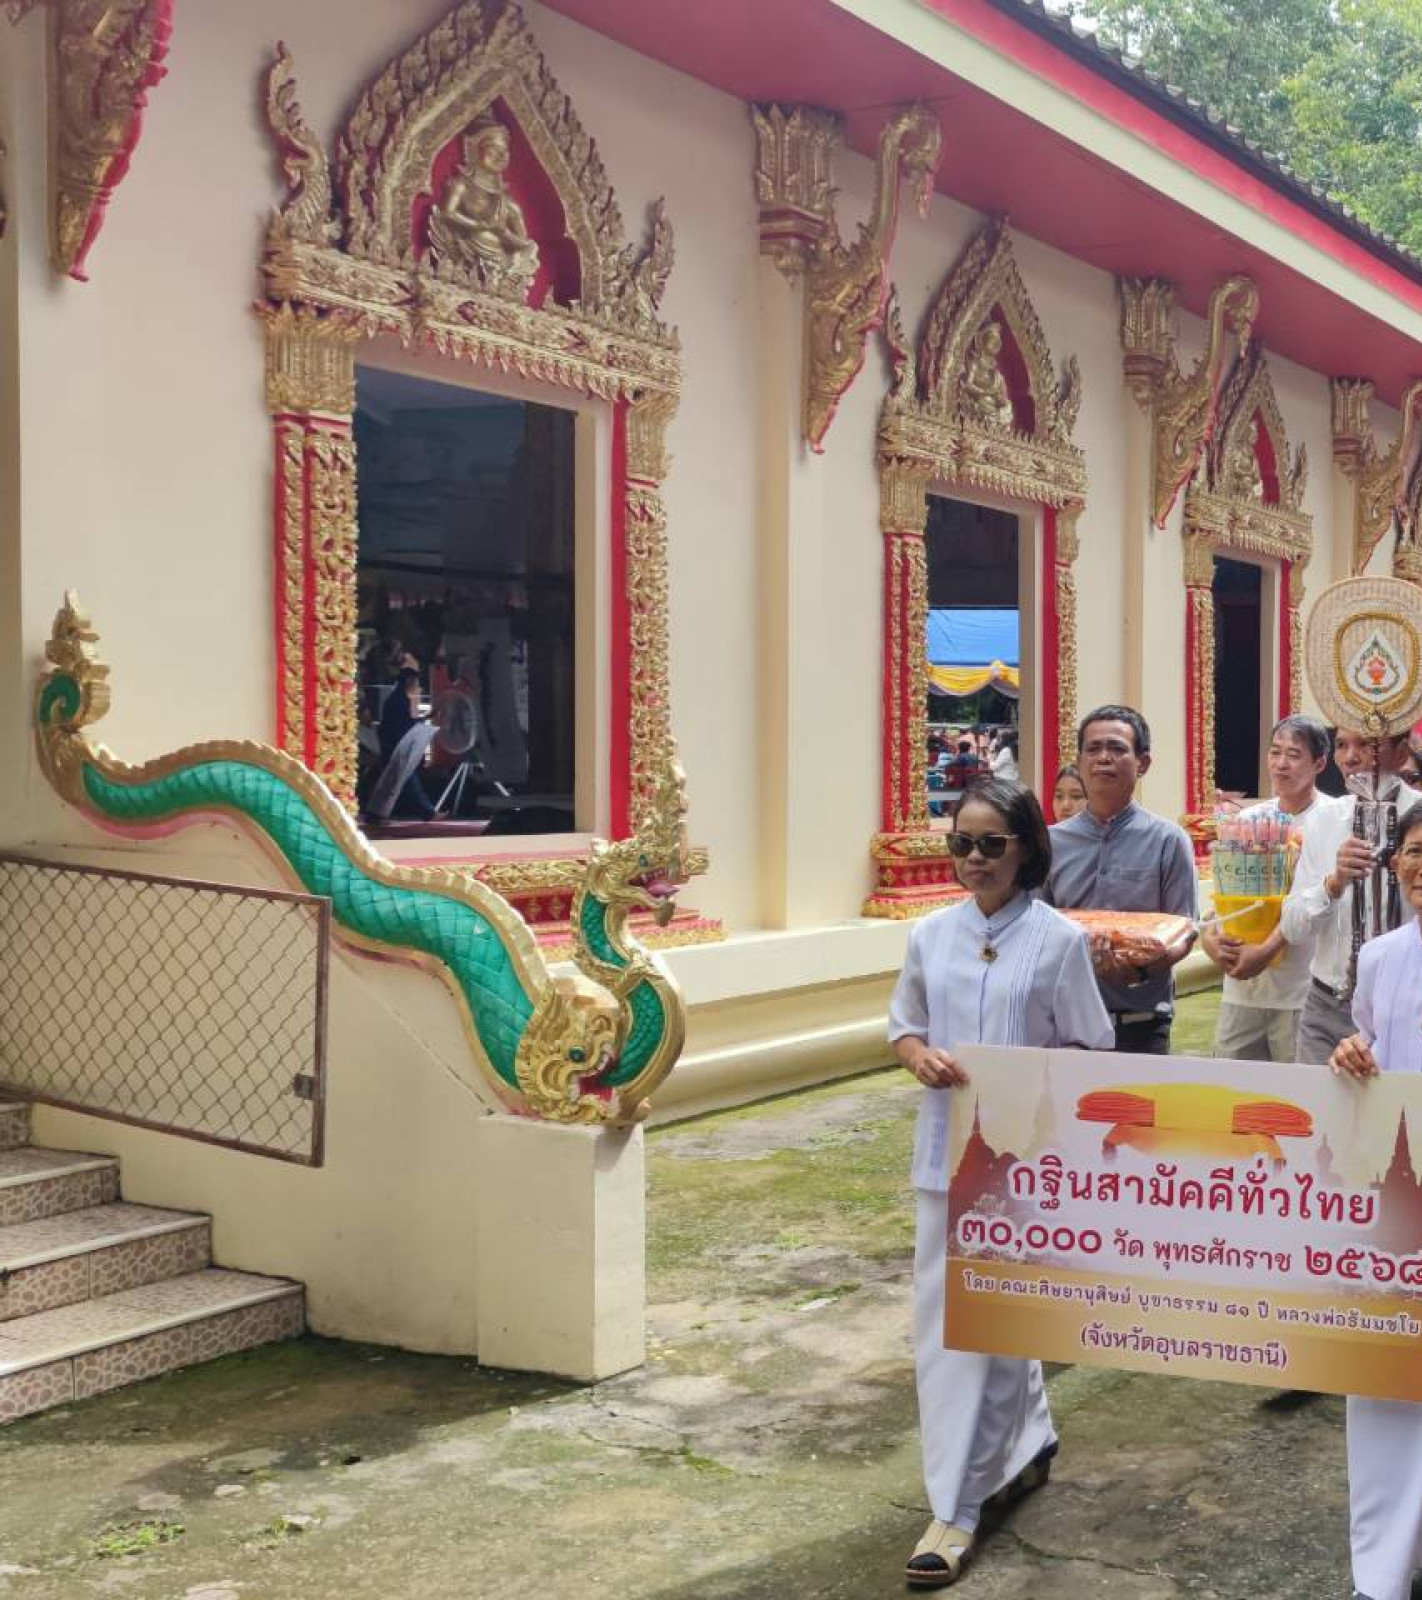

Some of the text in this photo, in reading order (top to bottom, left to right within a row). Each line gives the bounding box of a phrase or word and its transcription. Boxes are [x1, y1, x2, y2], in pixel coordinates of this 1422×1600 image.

[1012, 1155, 1374, 1225] กฐินสามัคคีทั่วไทย
[961, 1218, 1102, 1253] ๓๐,๐๐๐
[1113, 1228, 1144, 1257] วัด
[1152, 1238, 1291, 1273] พุทธศักราช
[964, 1271, 995, 1291] โดย
[1000, 1279, 1131, 1306] คณะศิษยานุศิษย์
[1138, 1294, 1219, 1314] บูชาธรรม
[1257, 1300, 1270, 1320] ปี
[1080, 1322, 1288, 1368] (จังหวัดอุบลราชธานี)
